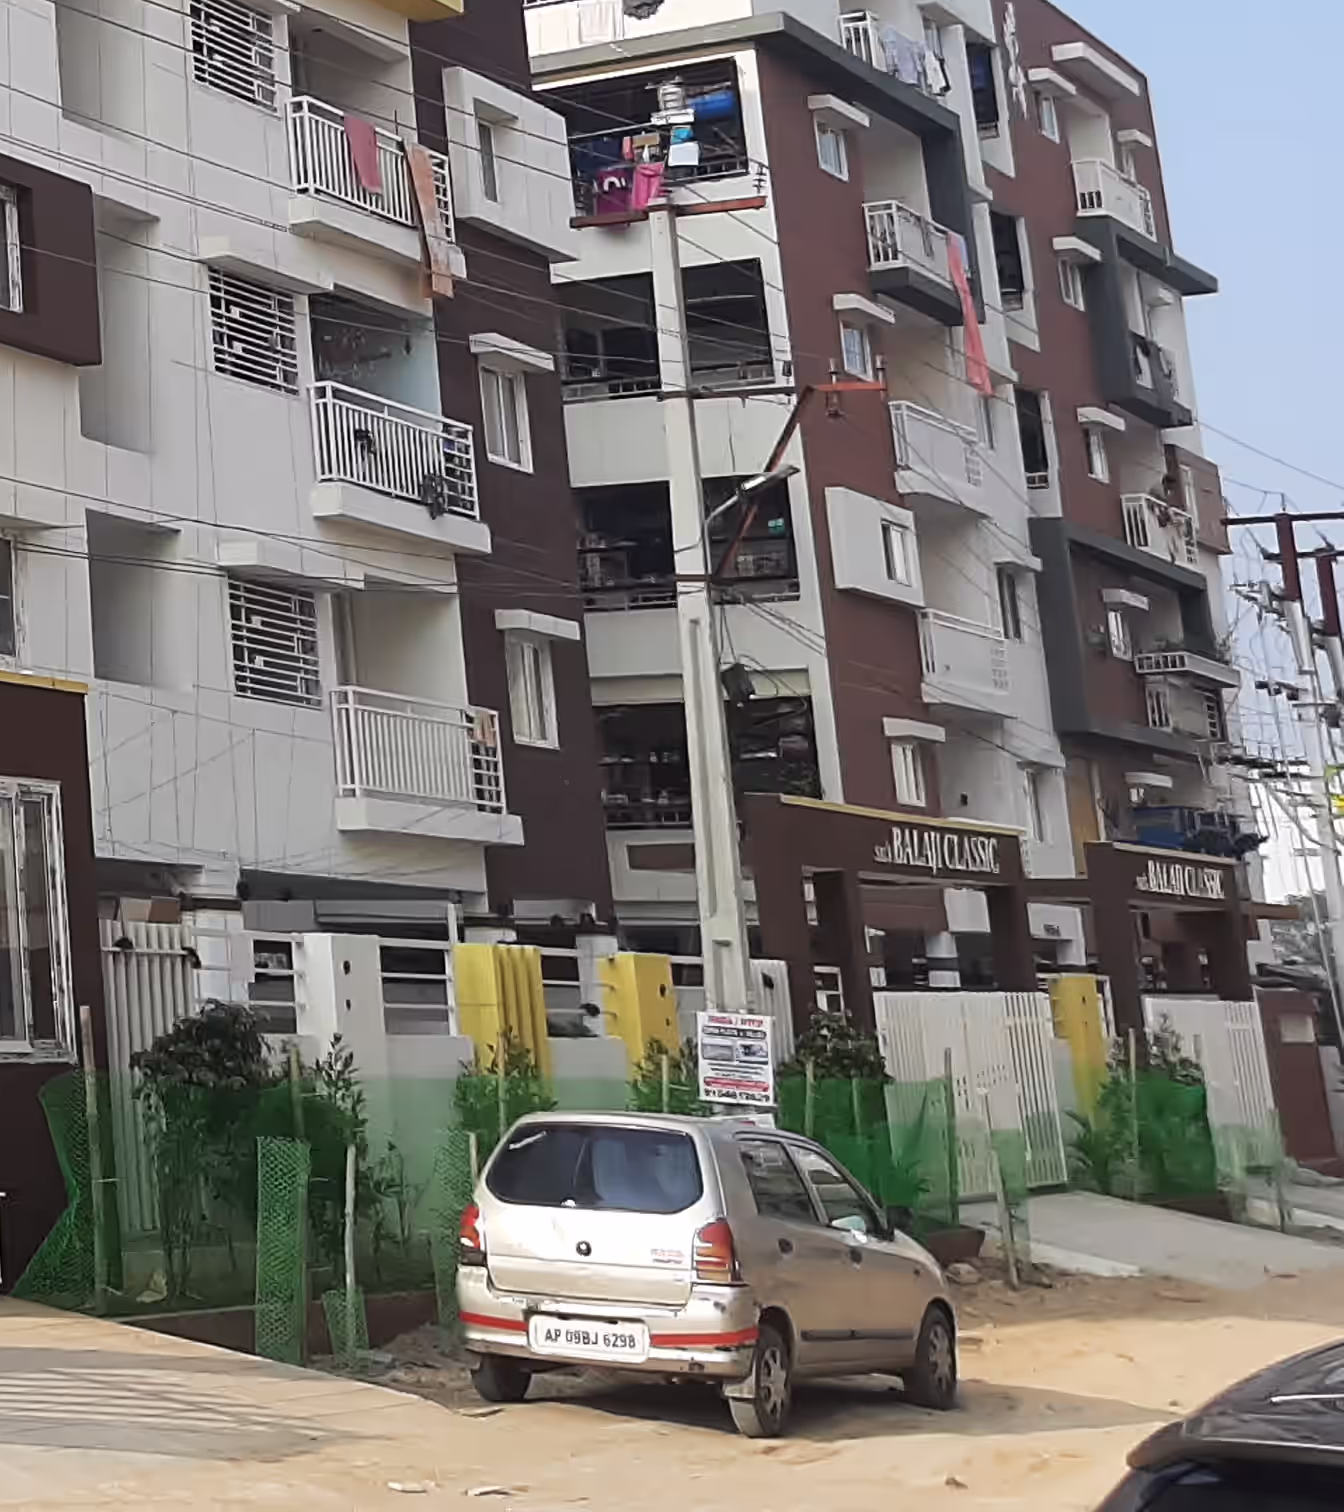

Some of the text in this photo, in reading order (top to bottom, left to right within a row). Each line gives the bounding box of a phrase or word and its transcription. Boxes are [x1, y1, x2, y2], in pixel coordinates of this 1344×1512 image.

[892, 826, 943, 876] BALAJI
[943, 833, 999, 874] CLASSIC
[544, 1328, 562, 1343] AP
[603, 1332, 637, 1349] 6298
